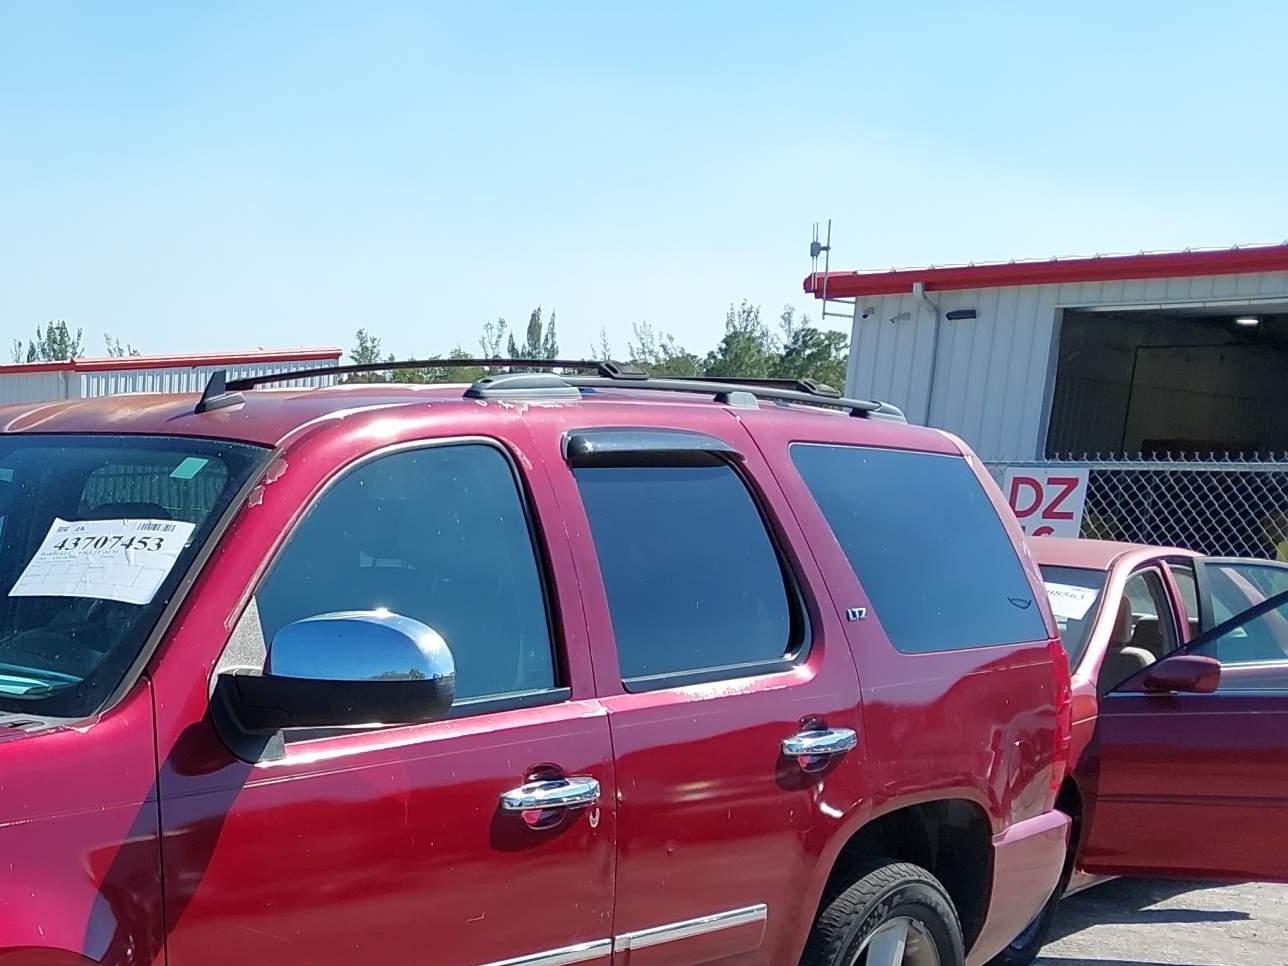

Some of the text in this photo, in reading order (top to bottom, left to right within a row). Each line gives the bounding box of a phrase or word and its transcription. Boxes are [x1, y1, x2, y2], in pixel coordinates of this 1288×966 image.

[1009, 476, 1080, 520] DZ
[52, 535, 165, 552] 43707453
[846, 607, 866, 621] LTZ
